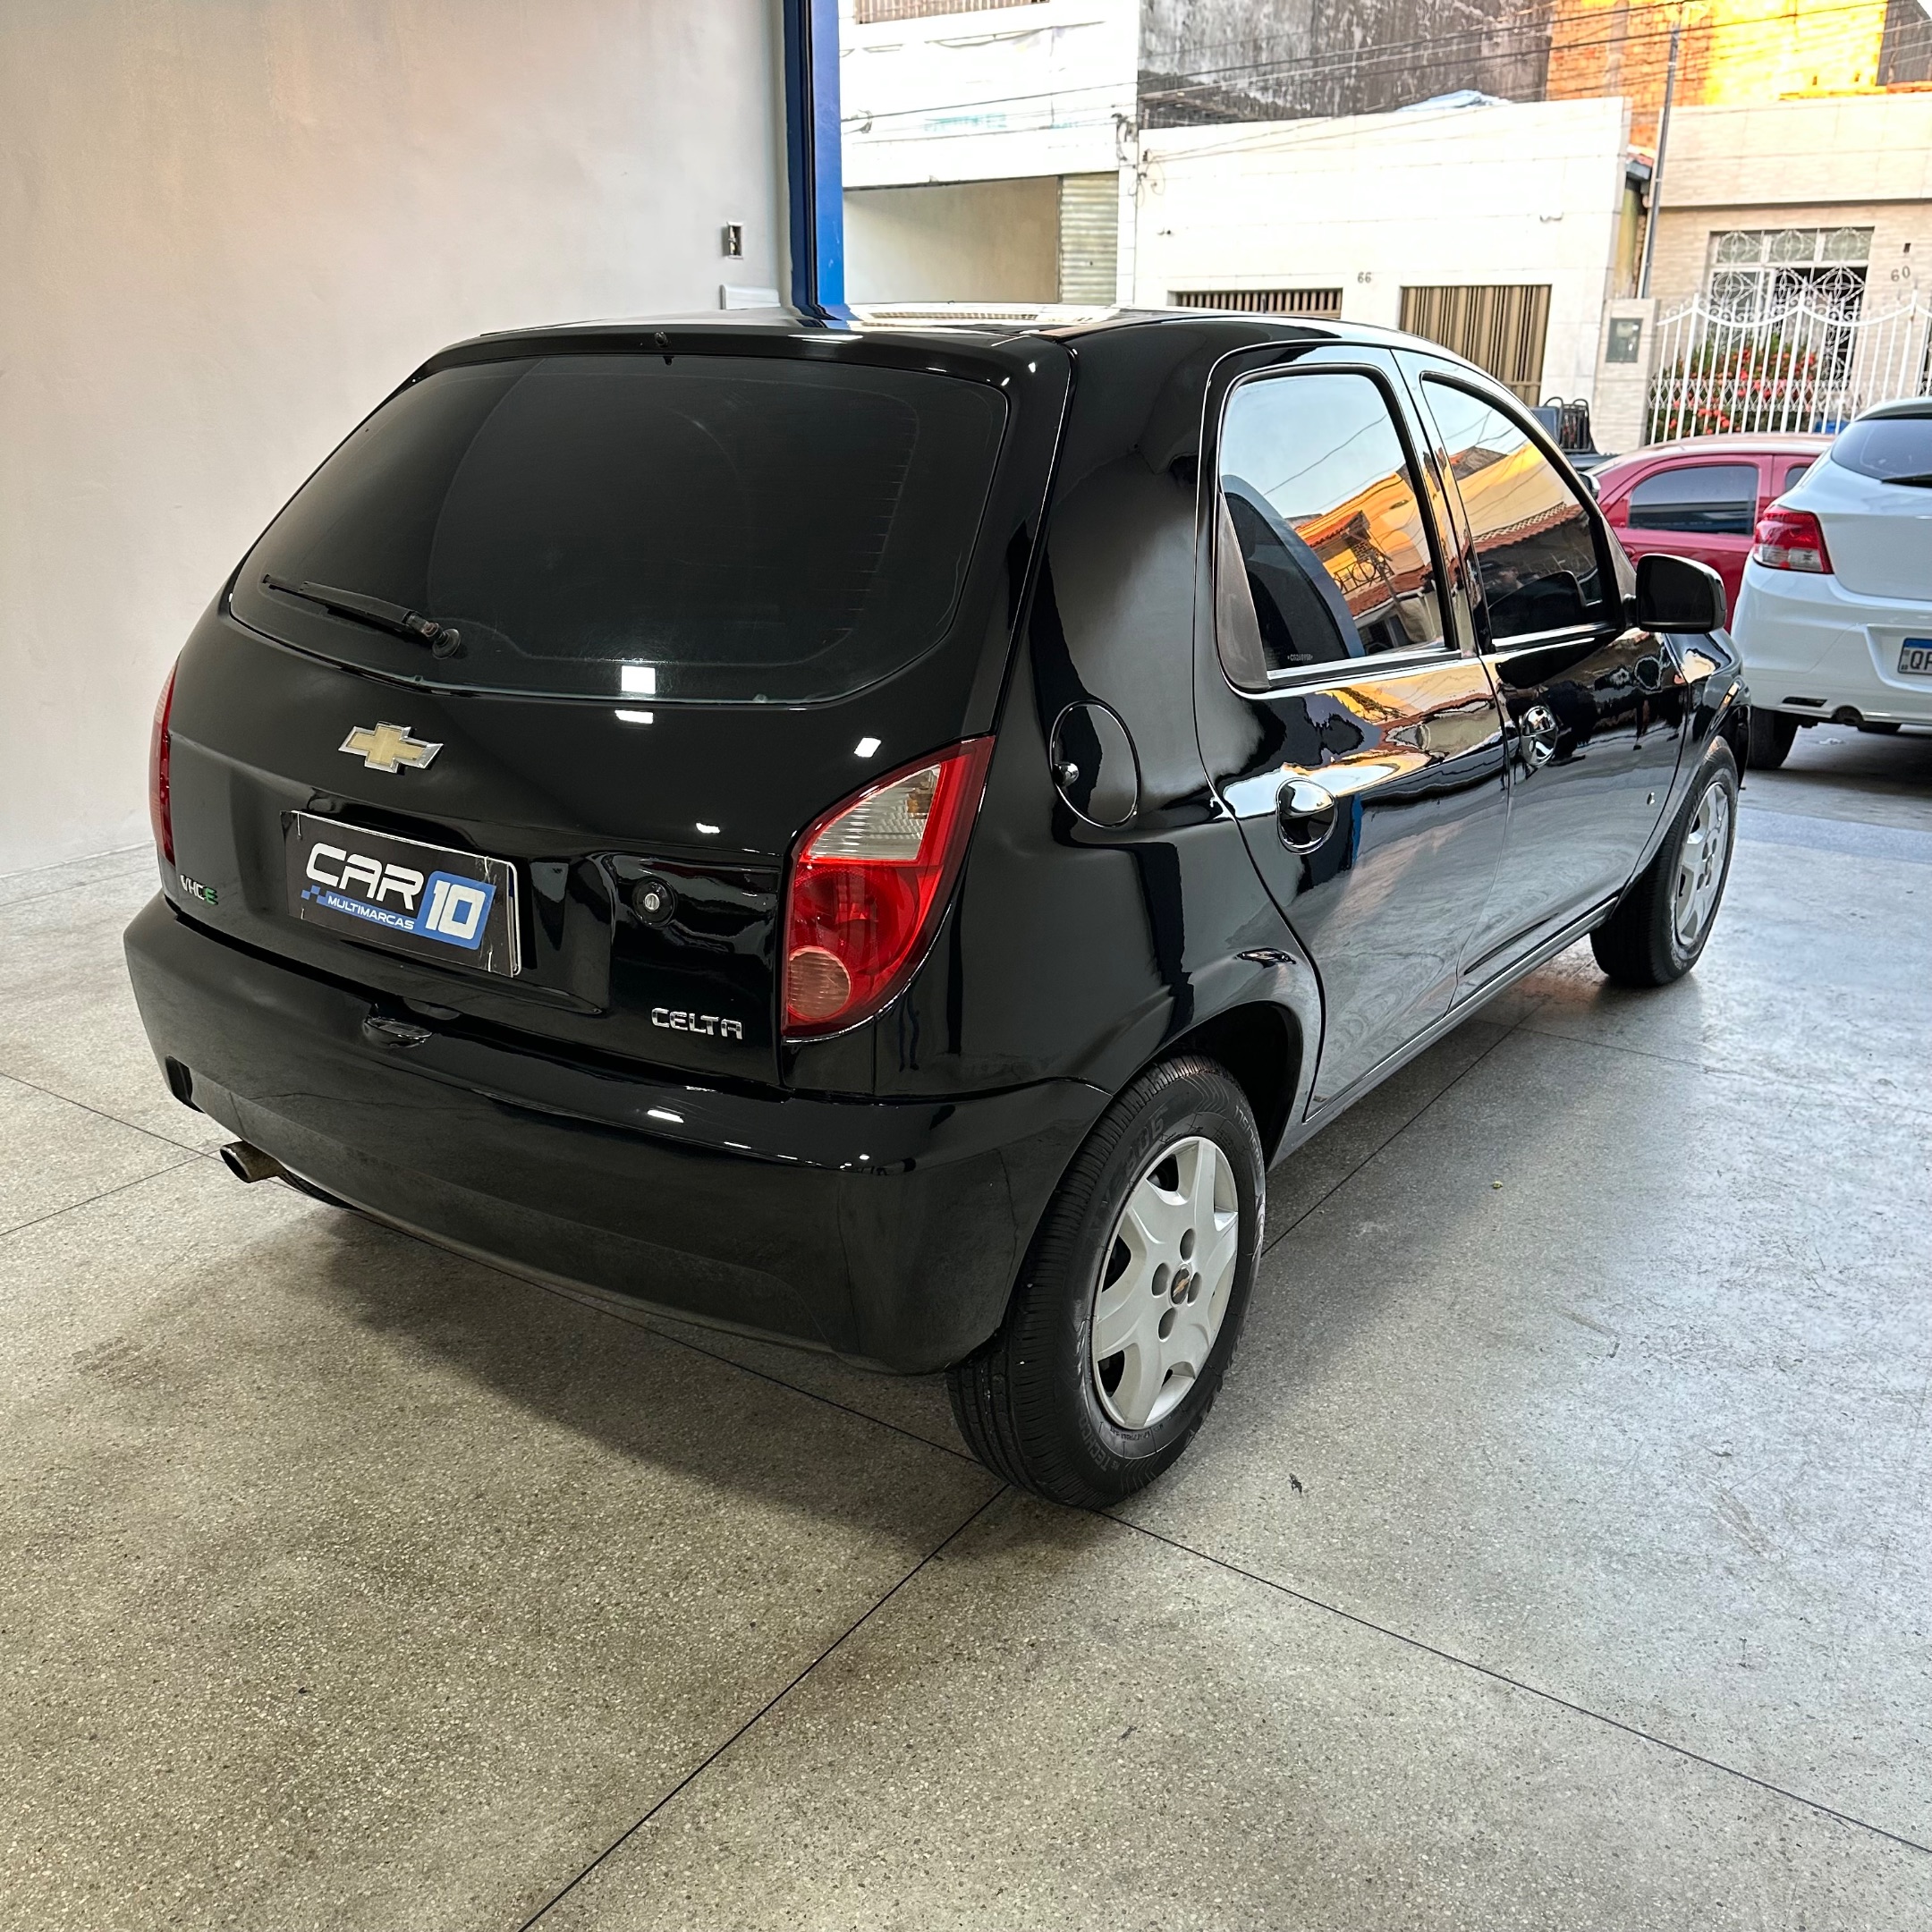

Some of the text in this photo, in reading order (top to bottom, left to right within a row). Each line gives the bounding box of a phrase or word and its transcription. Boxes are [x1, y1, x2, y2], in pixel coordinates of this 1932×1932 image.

[1357, 271, 1372, 284] 66
[1890, 266, 1911, 283] 60
[180, 874, 218, 905] VHCE
[306, 843, 486, 940] CAR 10
[327, 894, 415, 930] MULTIMARCAS
[651, 1007, 743, 1039] CELTA
